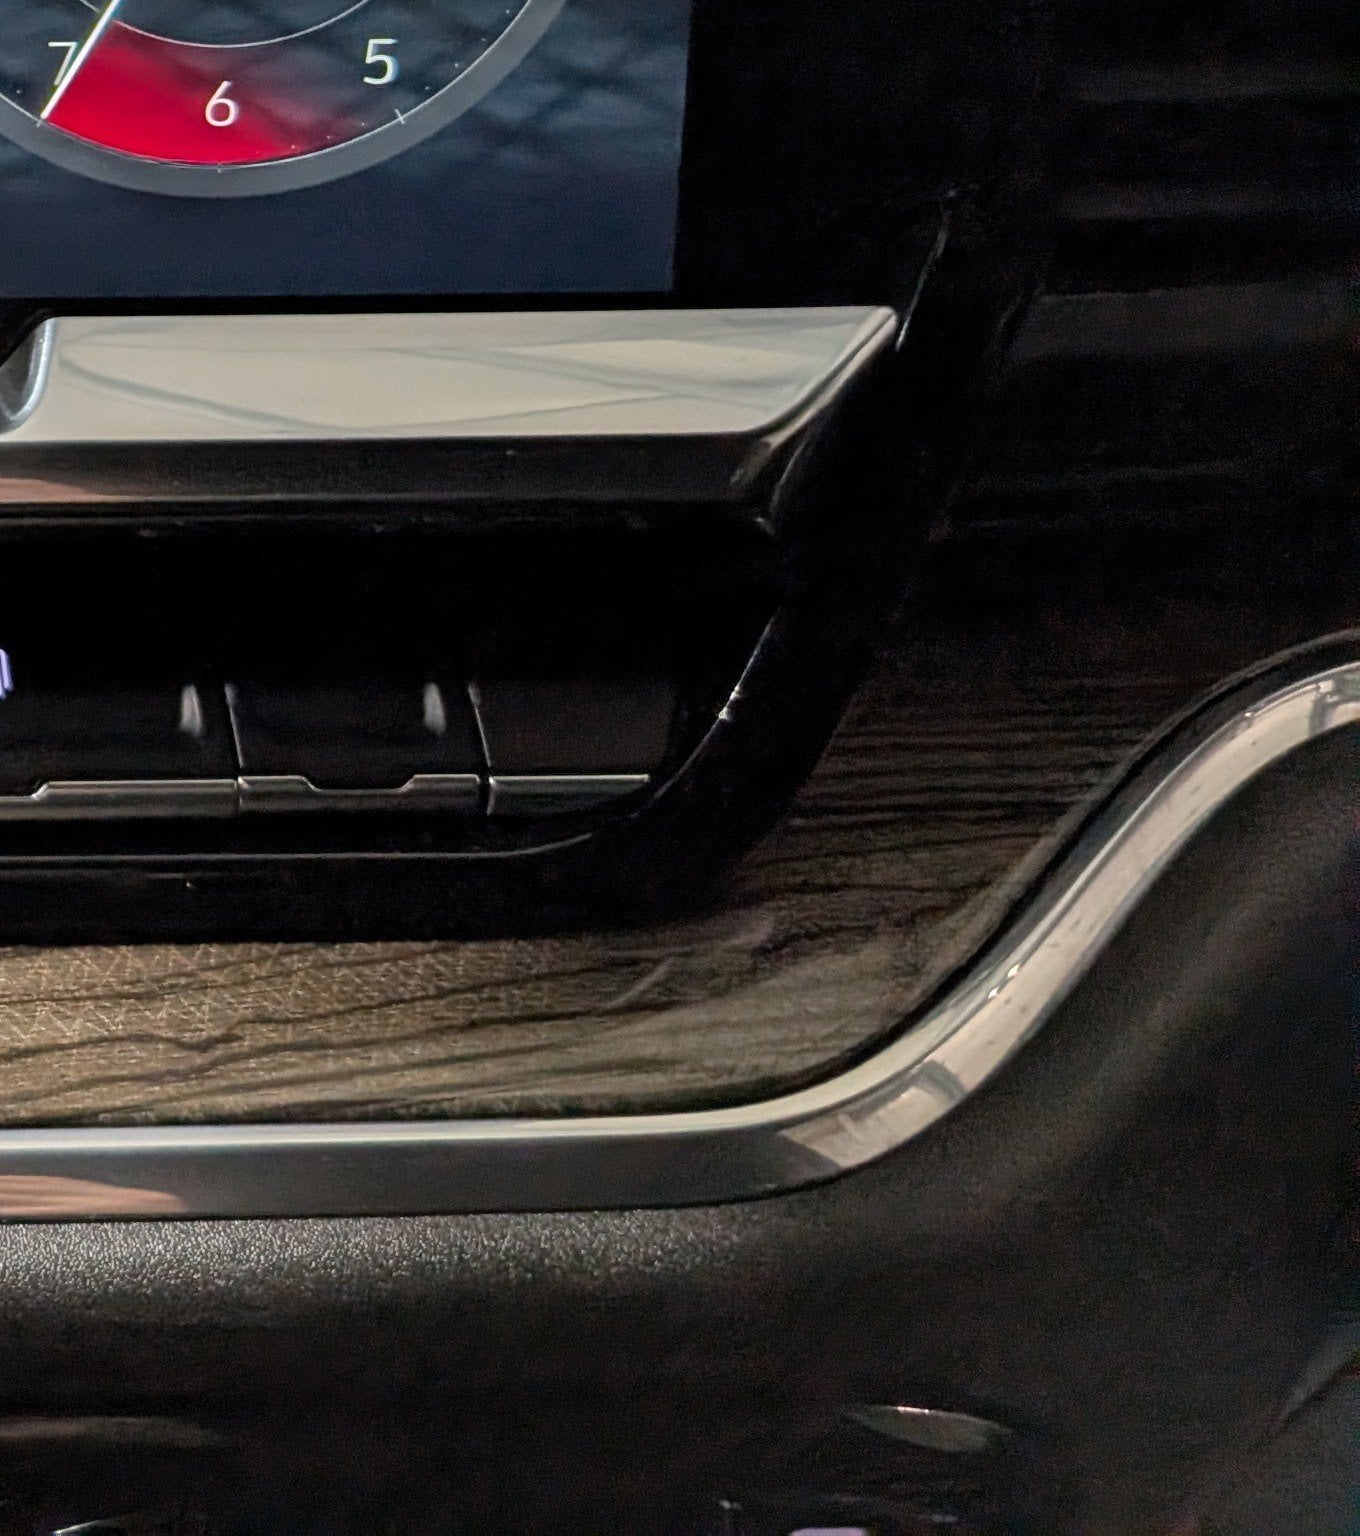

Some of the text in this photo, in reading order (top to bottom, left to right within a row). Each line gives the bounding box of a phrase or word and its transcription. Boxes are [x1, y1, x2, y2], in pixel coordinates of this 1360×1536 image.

[47, 41, 78, 86] 7
[363, 38, 398, 85] 5
[205, 80, 239, 127] 6
